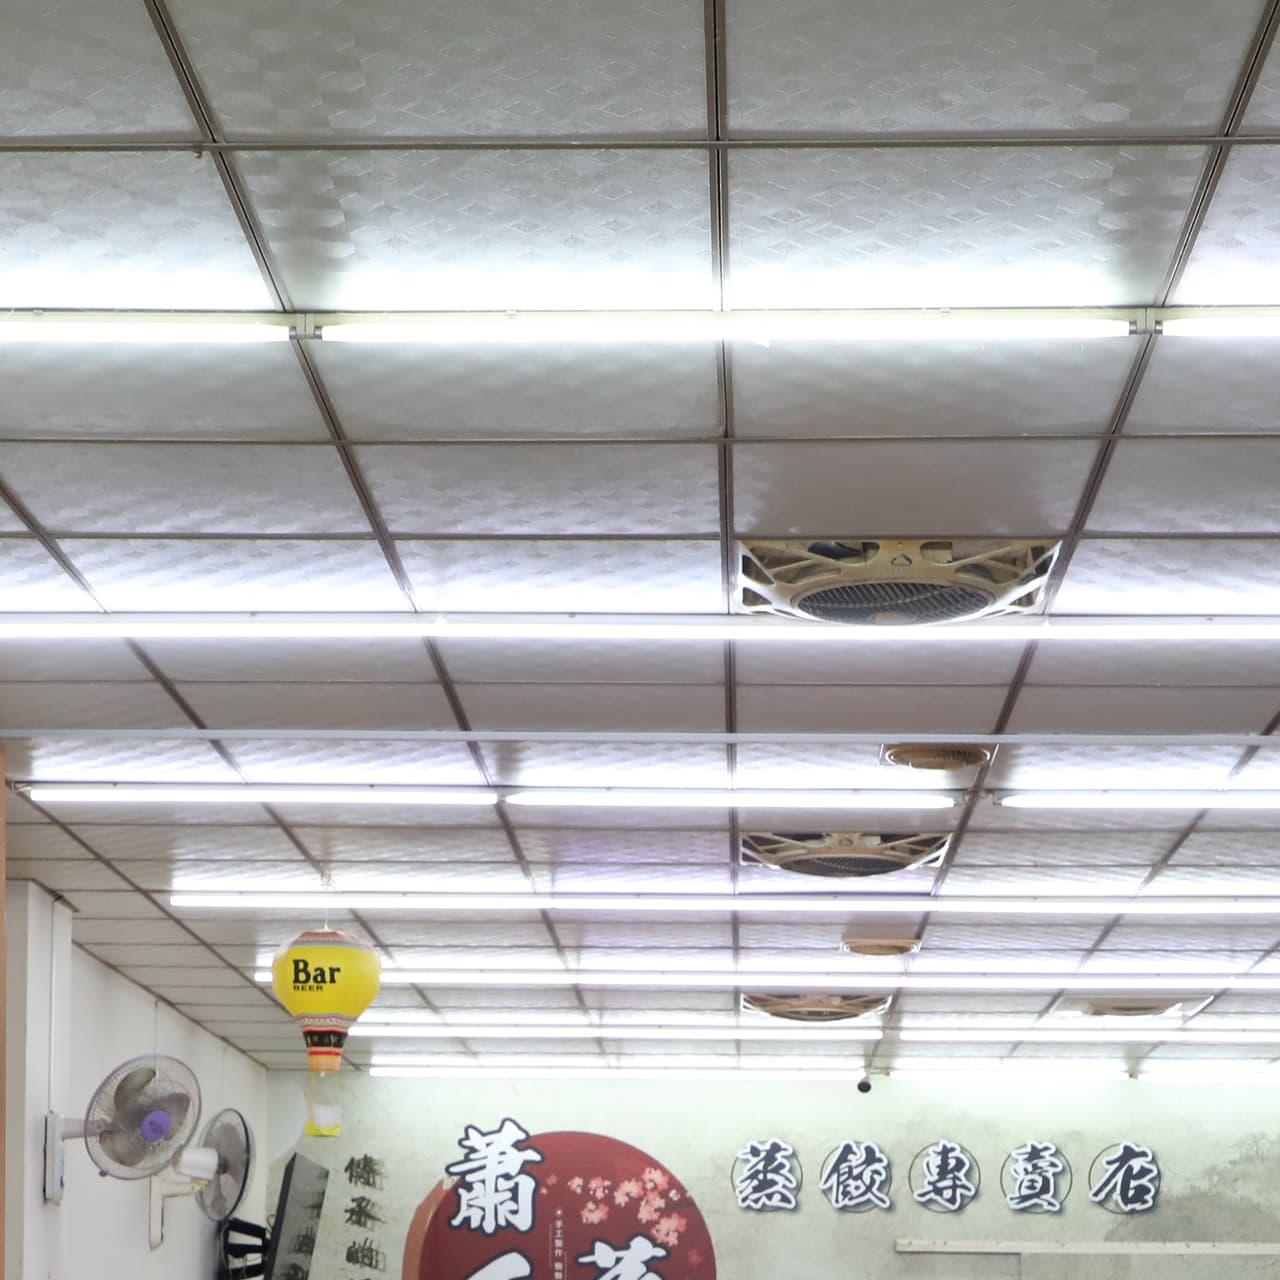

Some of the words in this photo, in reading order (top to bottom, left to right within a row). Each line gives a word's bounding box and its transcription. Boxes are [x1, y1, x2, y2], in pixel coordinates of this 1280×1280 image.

[292, 959, 341, 984] Bar
[733, 1138, 1160, 1213] 蒸餃專賣店
